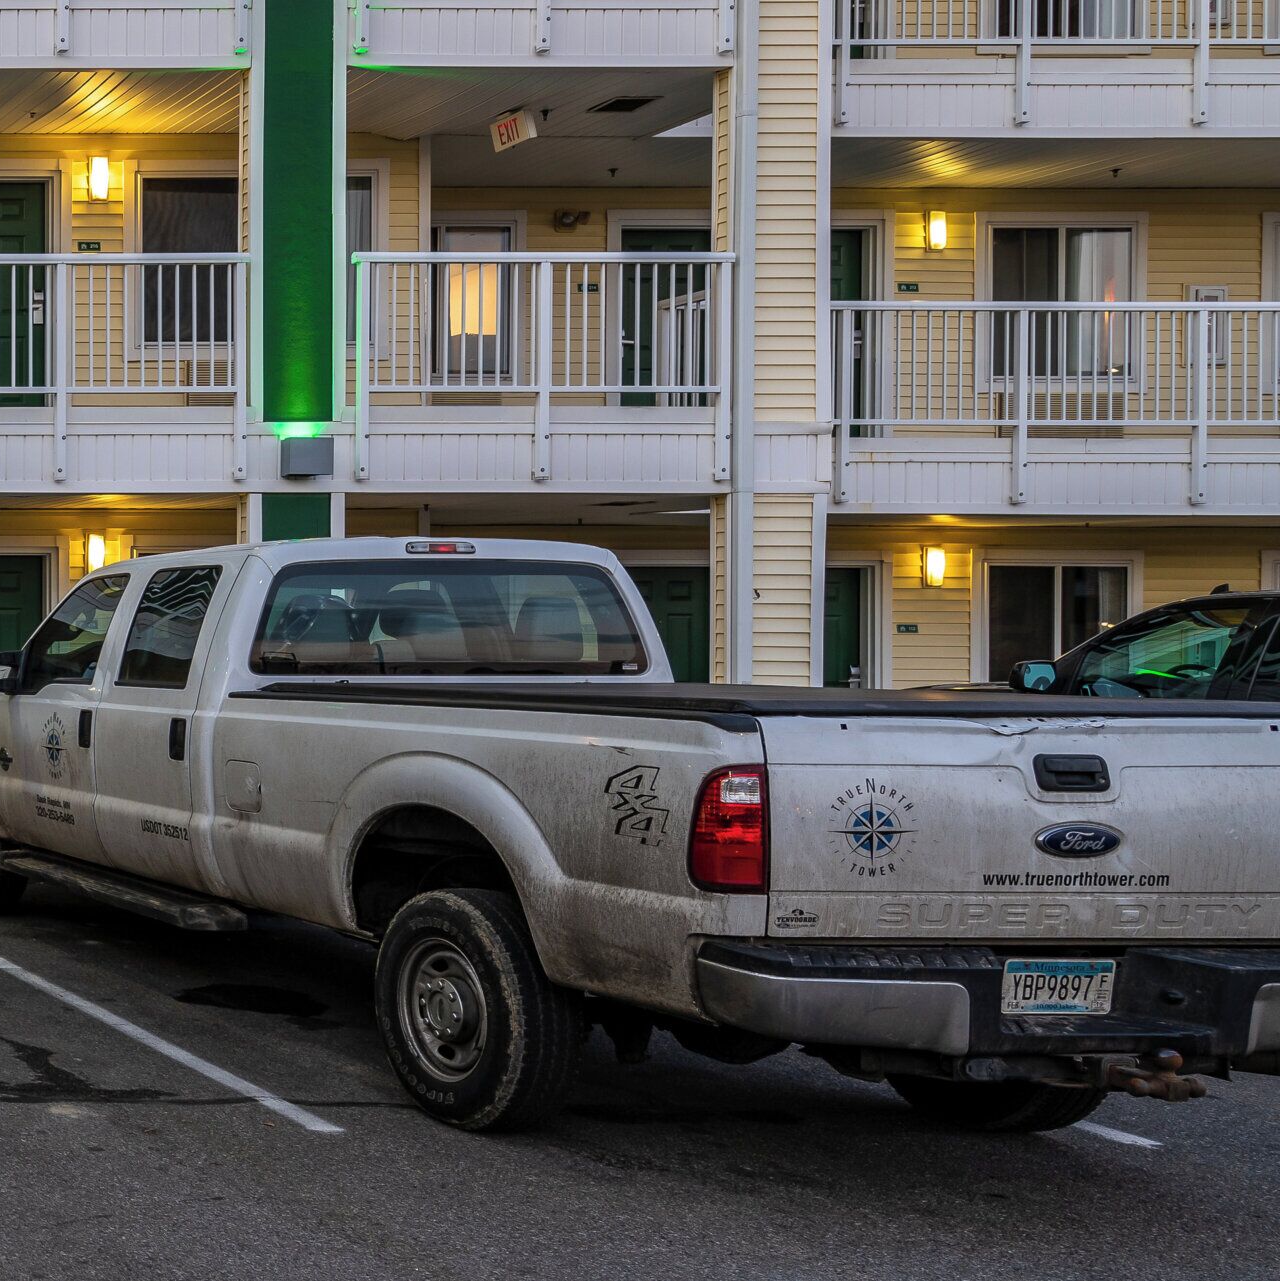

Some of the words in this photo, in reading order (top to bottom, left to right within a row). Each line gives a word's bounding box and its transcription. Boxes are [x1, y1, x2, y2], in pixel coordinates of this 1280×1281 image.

[497, 117, 521, 147] EXIT
[140, 817, 162, 836] USDOT
[163, 823, 189, 841] 352512
[1060, 831, 1106, 850] Ford
[849, 862, 897, 878] TOWER
[982, 871, 1170, 887] www.truenorthtower.com
[876, 902, 1071, 929] SUPER
[1111, 902, 1262, 929] DUTY
[1034, 962, 1086, 973] Minnesota
[1013, 974, 1095, 1001] YBP9897
[1099, 975, 1109, 988] F
